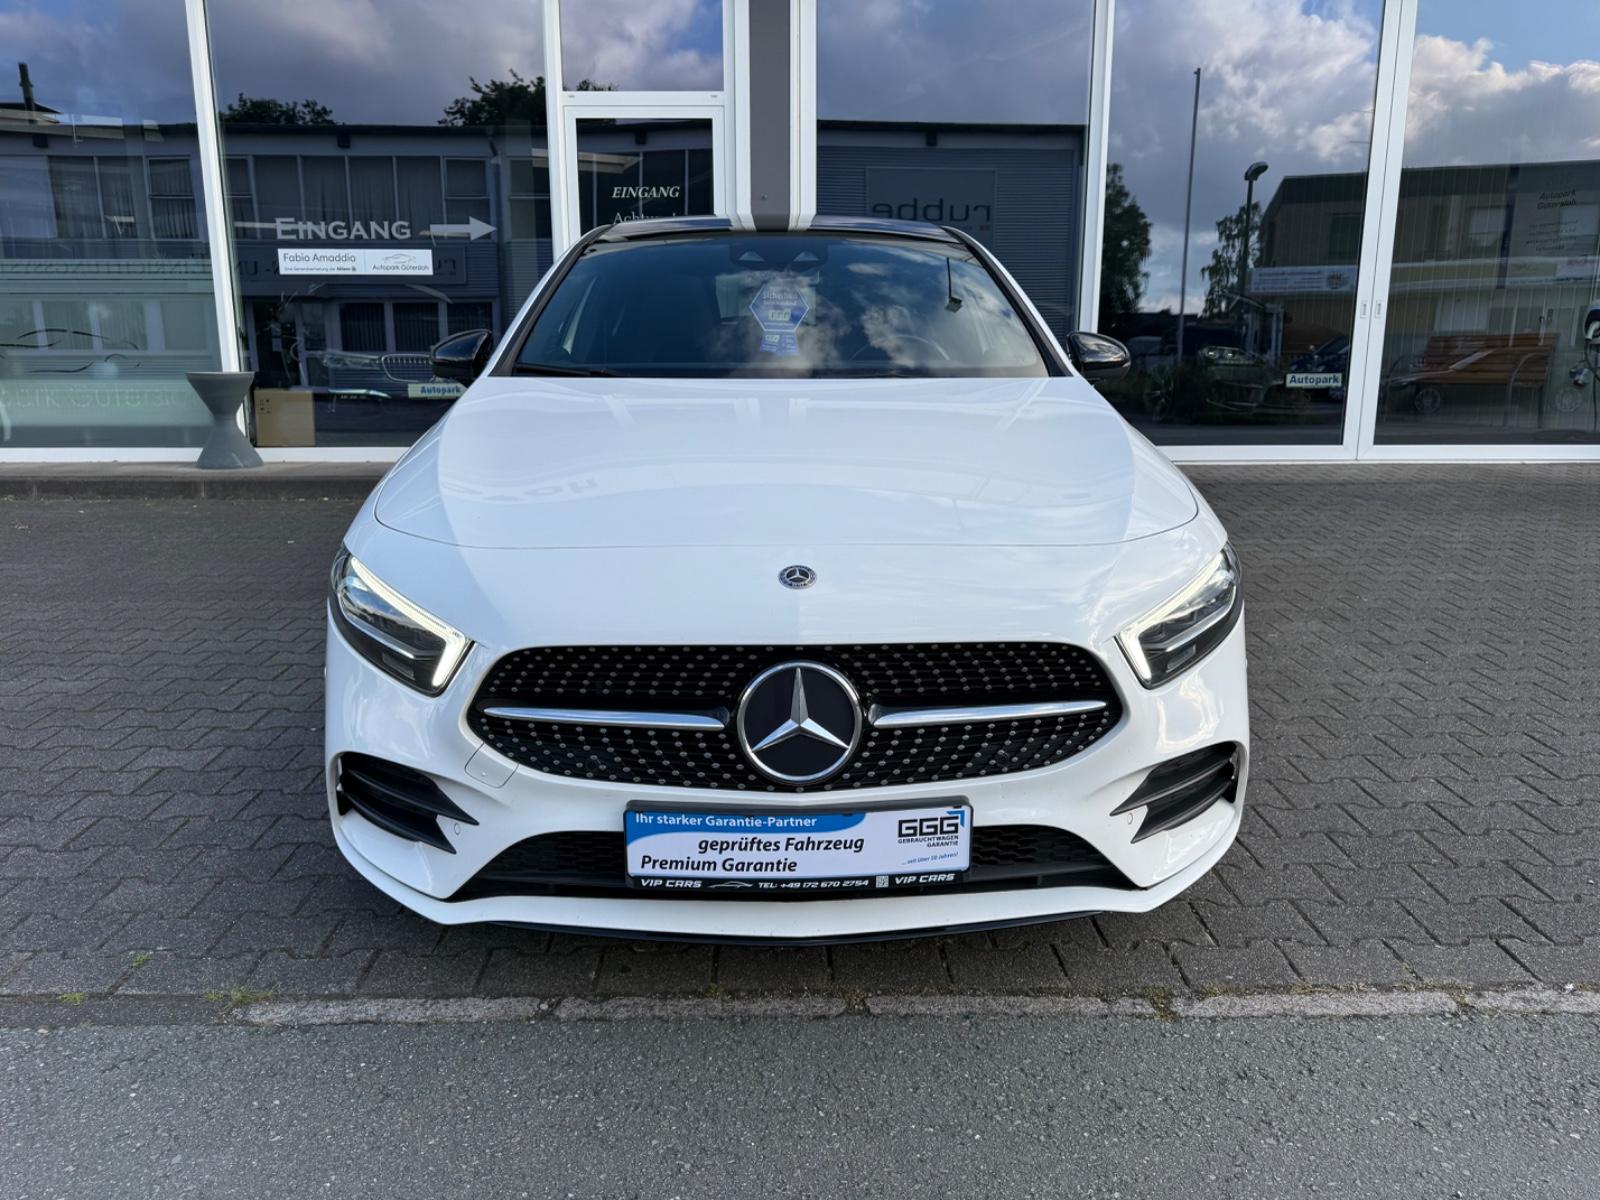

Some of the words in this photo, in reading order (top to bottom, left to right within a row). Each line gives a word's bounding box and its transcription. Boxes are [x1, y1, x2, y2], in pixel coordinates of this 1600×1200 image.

[612, 186, 680, 198] EINGANG
[283, 253, 310, 263] Fabio
[312, 253, 356, 263] Amaddio
[372, 264, 400, 272] Autopark
[1289, 374, 1340, 386] Autopark
[420, 384, 460, 396] Autopark
[635, 813, 653, 824] Ihr
[656, 814, 702, 826] starker
[705, 815, 817, 828] Garantie-Partner
[897, 815, 959, 838] GGG
[698, 836, 781, 854] geprüftes
[784, 836, 865, 853] Fahrzeug
[897, 835, 959, 844] GEBRAUCHTWAGEN
[926, 840, 959, 848] GARANTIE
[640, 855, 717, 872] Premium
[721, 857, 798, 872] Garantie
[640, 879, 663, 888] VIP
[665, 880, 703, 889] CARS
[758, 881, 778, 889] TEL:
[780, 881, 801, 889] +49
[802, 881, 819, 889] 172
[820, 880, 841, 888] 670
[842, 879, 869, 887] 2754
[895, 875, 918, 885] VIP
[919, 873, 956, 883] CARS
